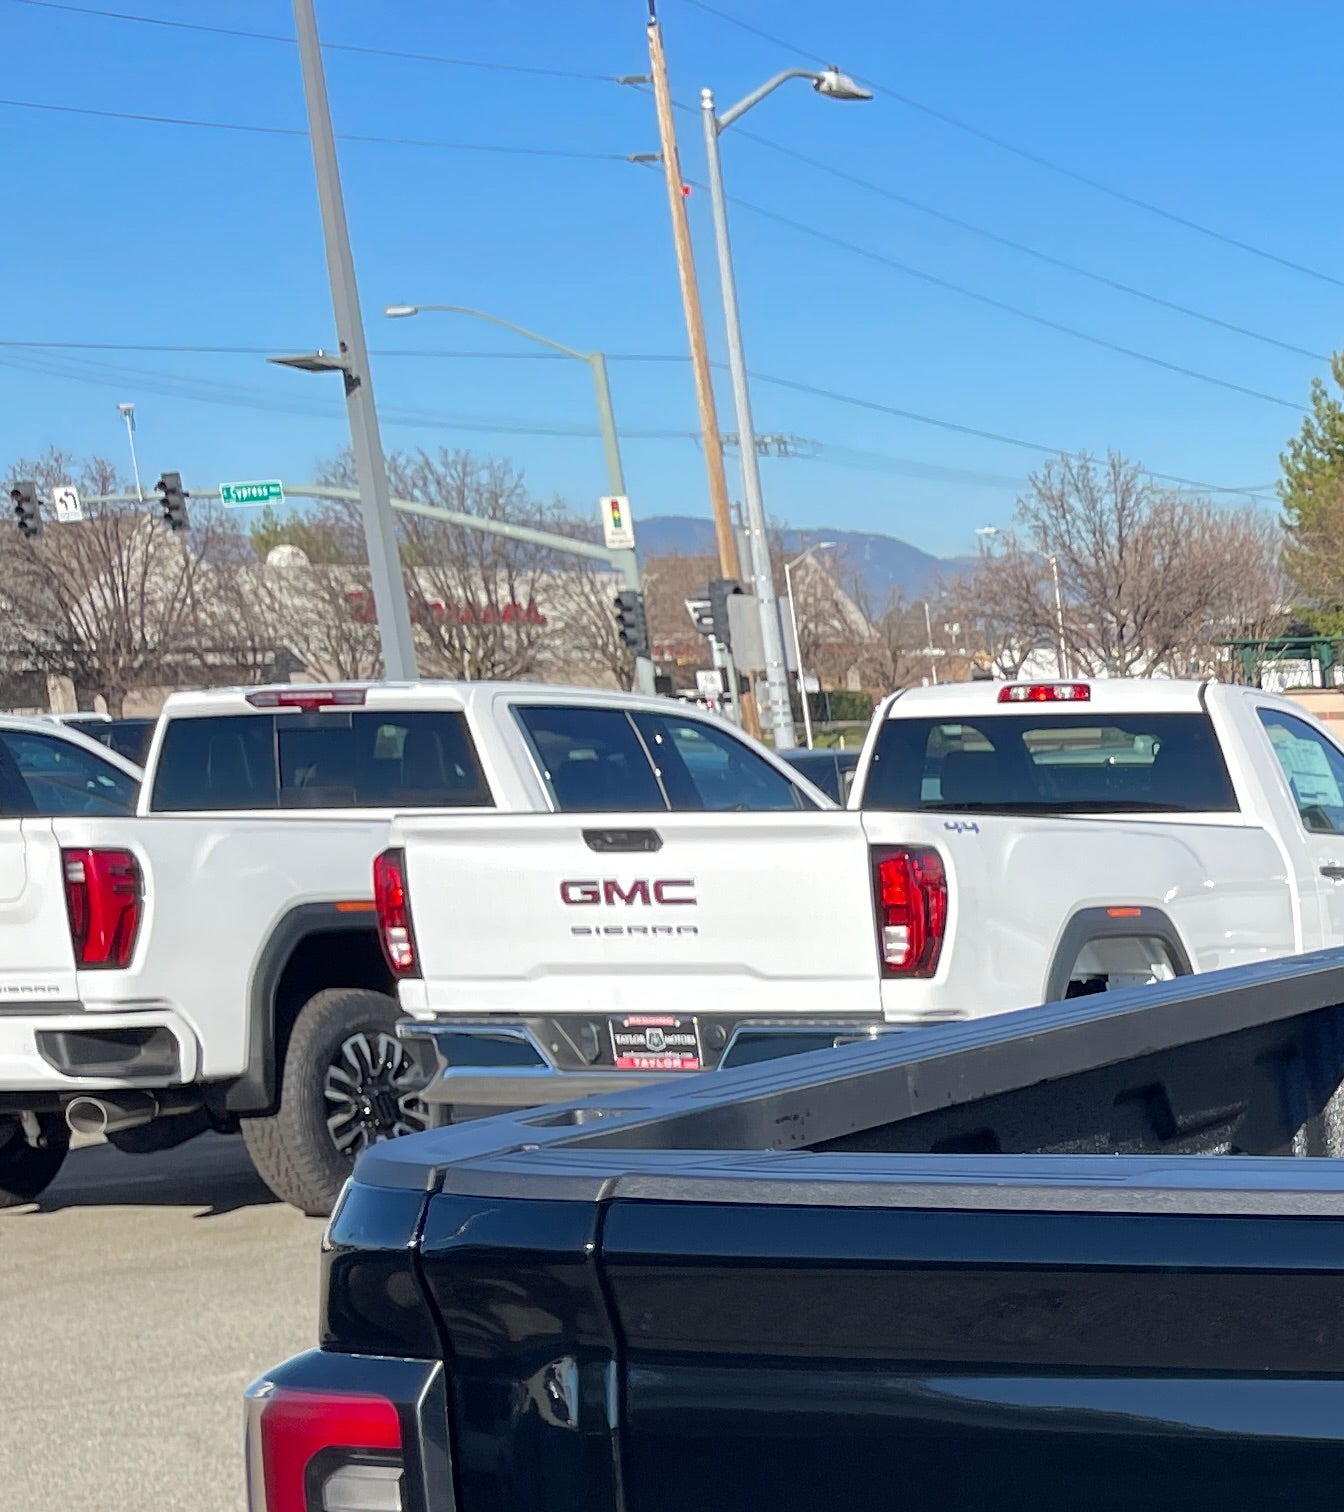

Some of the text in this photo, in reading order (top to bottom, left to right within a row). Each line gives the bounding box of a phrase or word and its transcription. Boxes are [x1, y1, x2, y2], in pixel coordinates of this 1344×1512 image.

[560, 879, 698, 906] GMC
[570, 925, 699, 936] SIERRA
[0, 985, 60, 993] IERRA
[633, 1058, 681, 1069] TAYLOR
